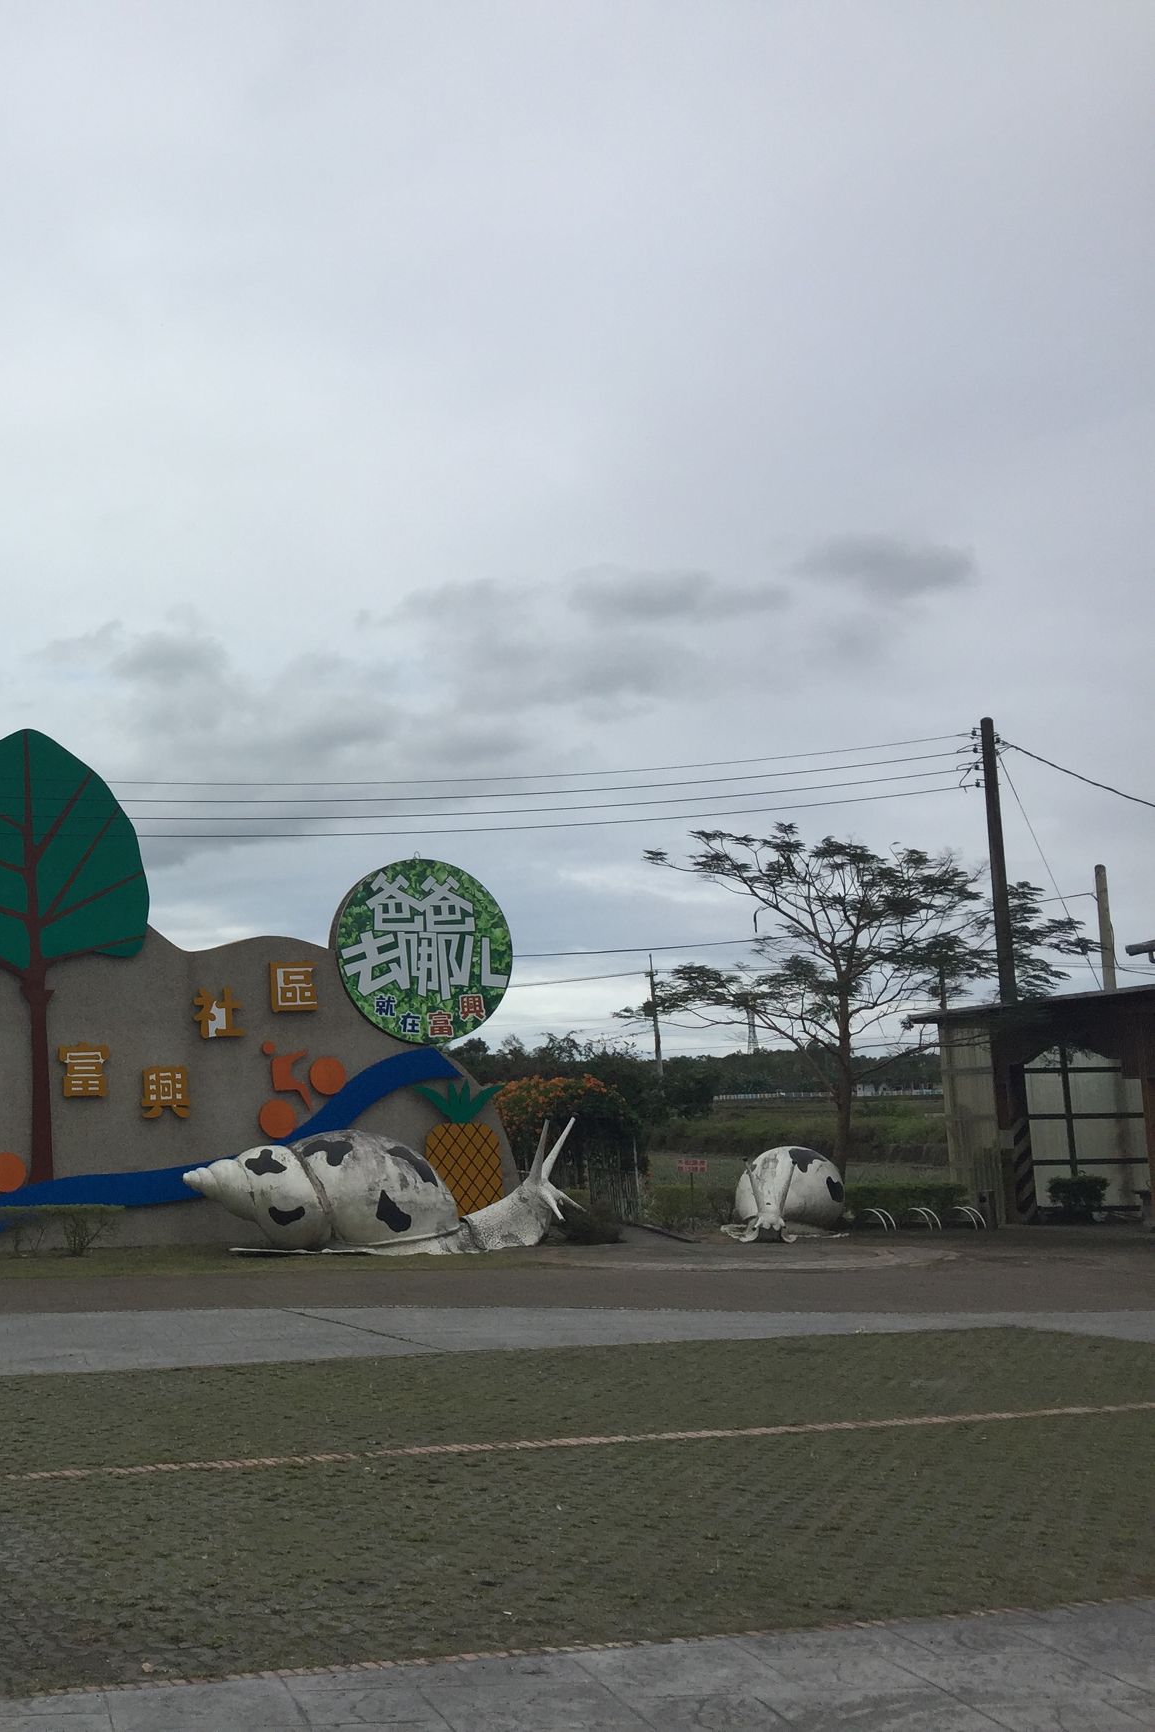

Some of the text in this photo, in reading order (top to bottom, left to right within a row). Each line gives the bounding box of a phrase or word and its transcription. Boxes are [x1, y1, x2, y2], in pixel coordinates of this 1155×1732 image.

[366, 871, 475, 932] 爸爸
[375, 994, 486, 1038] 就在富興
